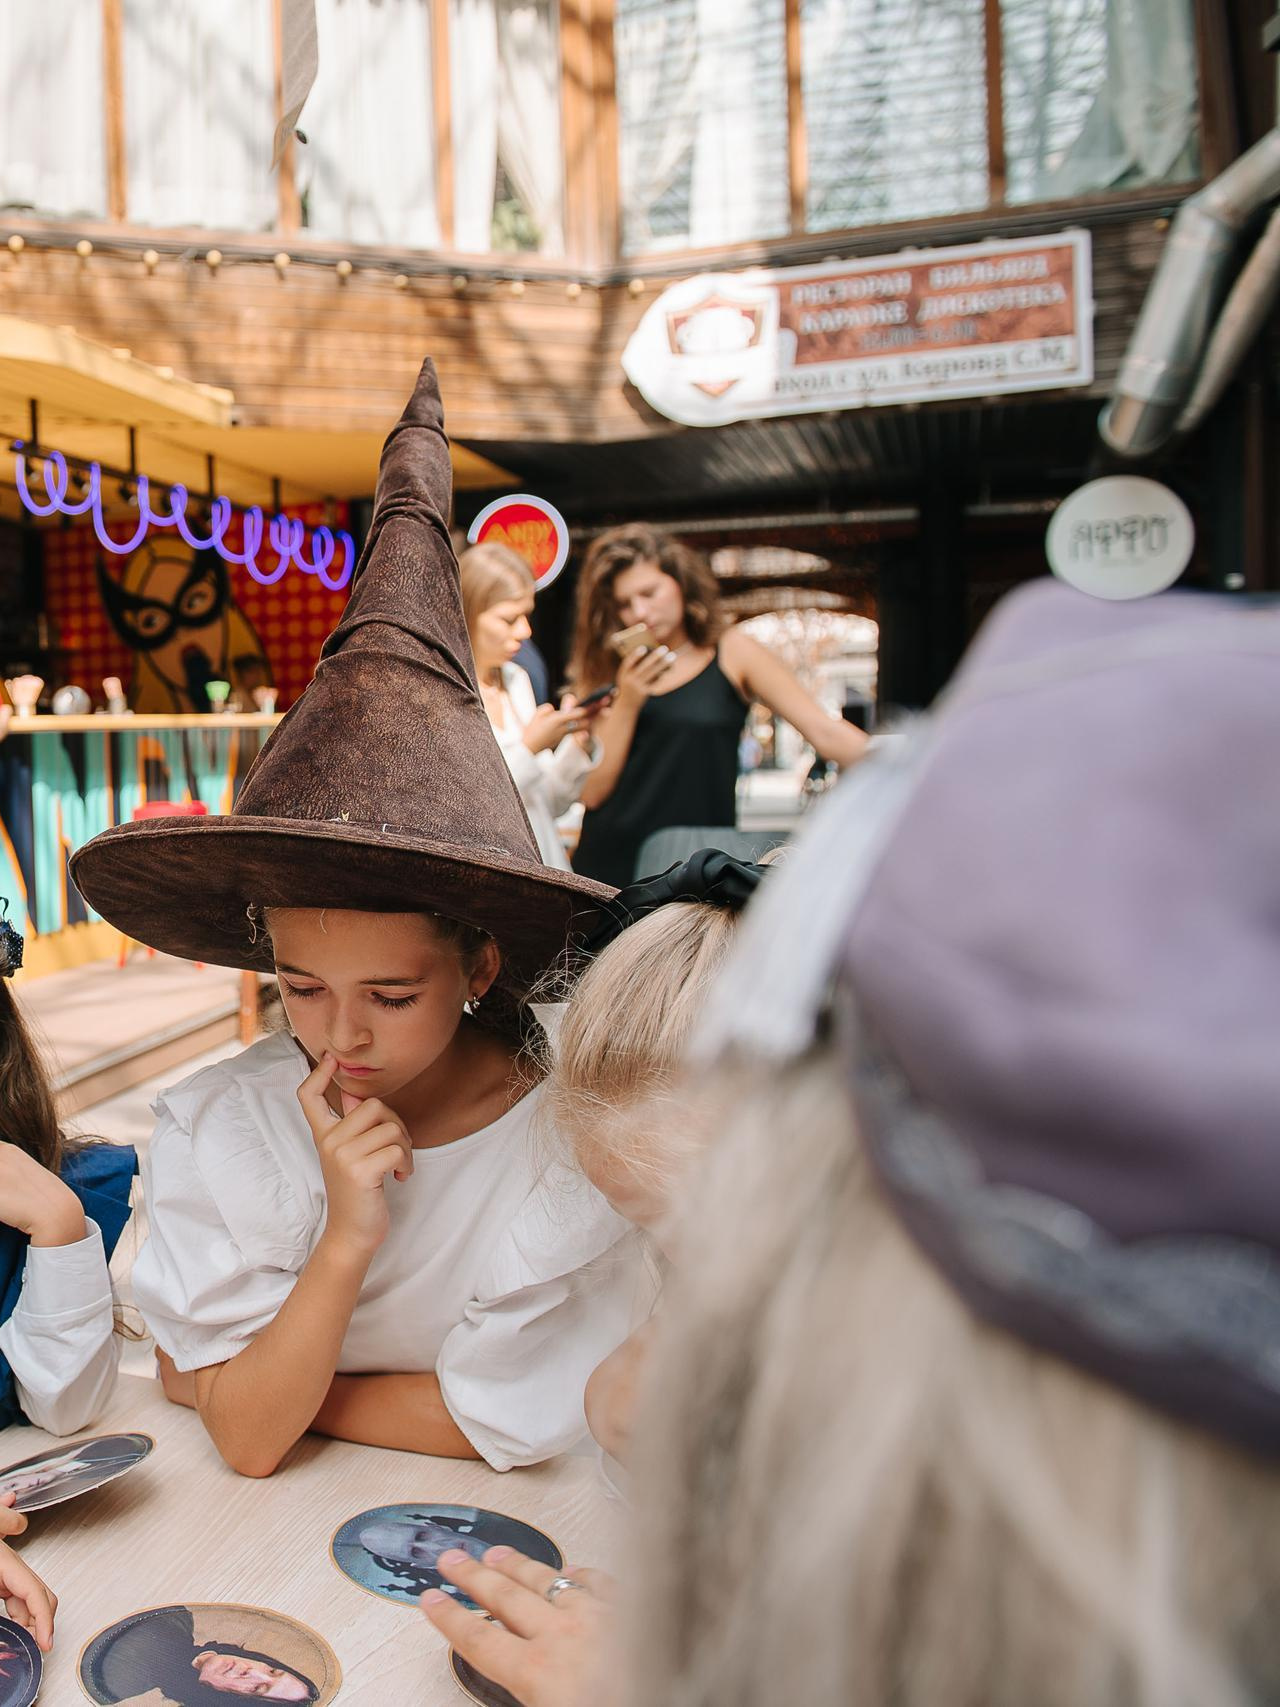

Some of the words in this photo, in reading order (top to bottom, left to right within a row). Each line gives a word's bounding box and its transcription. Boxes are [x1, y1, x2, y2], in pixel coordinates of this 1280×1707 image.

[793, 272, 912, 304] РЕСТОРАН
[801, 300, 908, 333] КАРАОКЕ
[918, 284, 1066, 319] ДИСКОТЕКА
